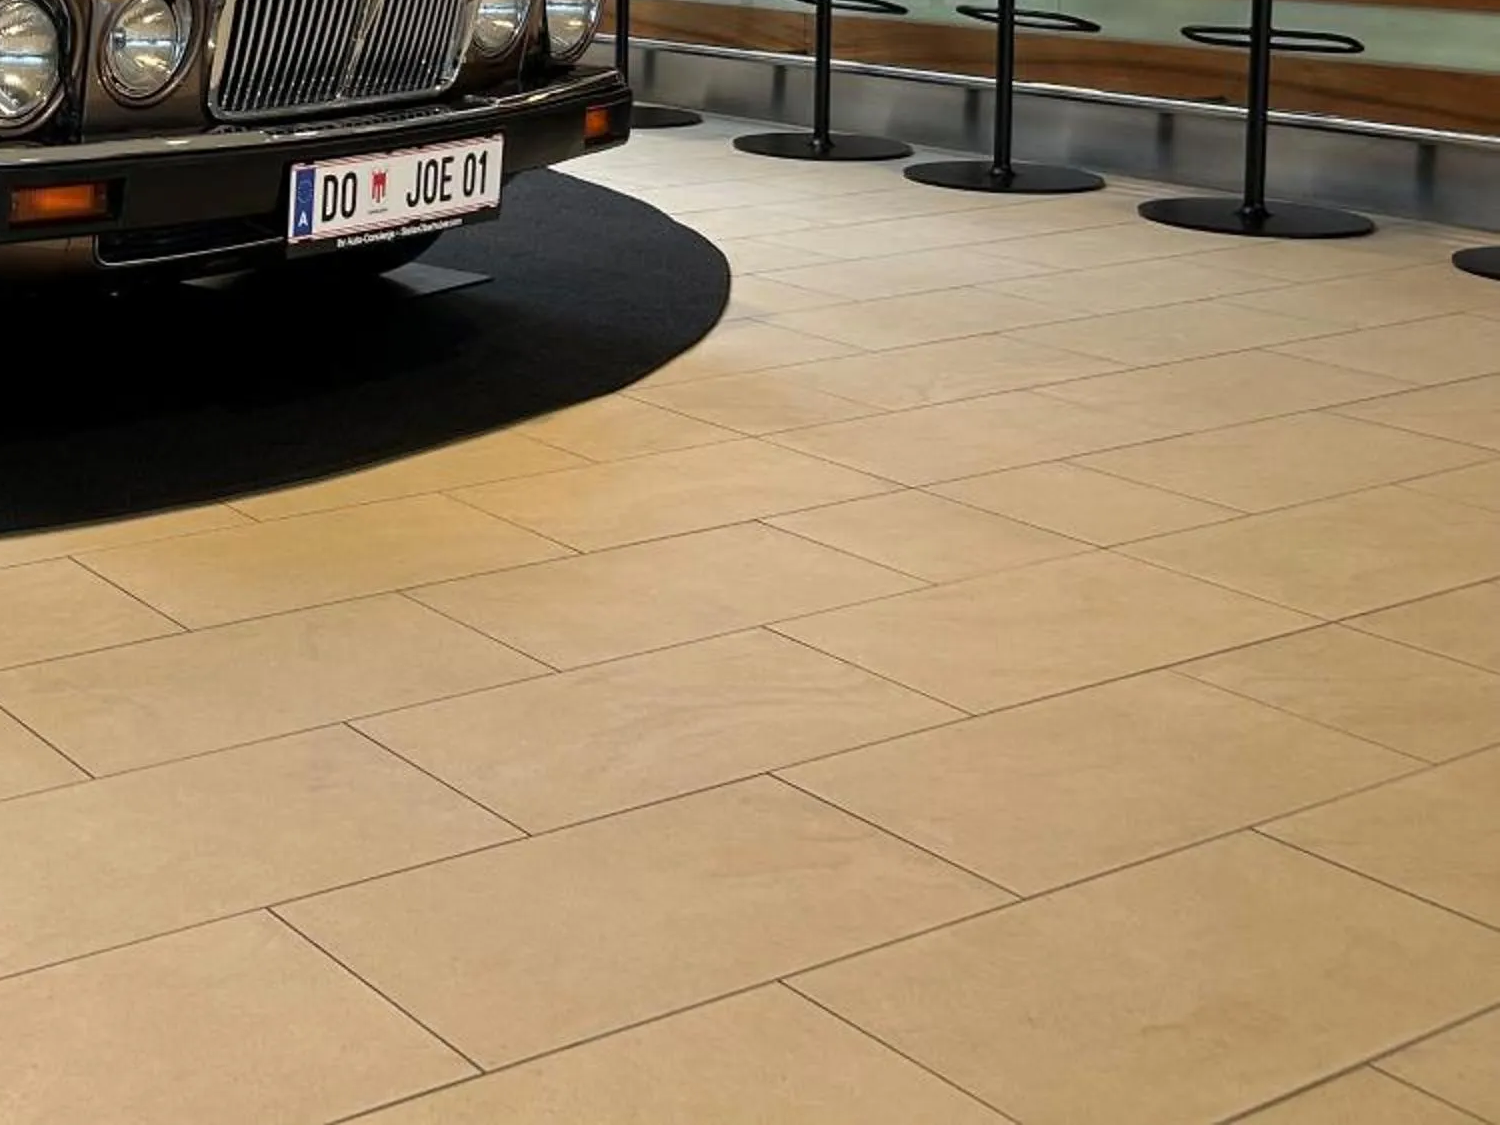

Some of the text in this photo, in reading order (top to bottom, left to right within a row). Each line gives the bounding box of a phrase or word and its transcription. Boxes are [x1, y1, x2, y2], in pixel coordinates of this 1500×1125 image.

[322, 150, 488, 222] DO JOE 01
[298, 211, 309, 227] A
